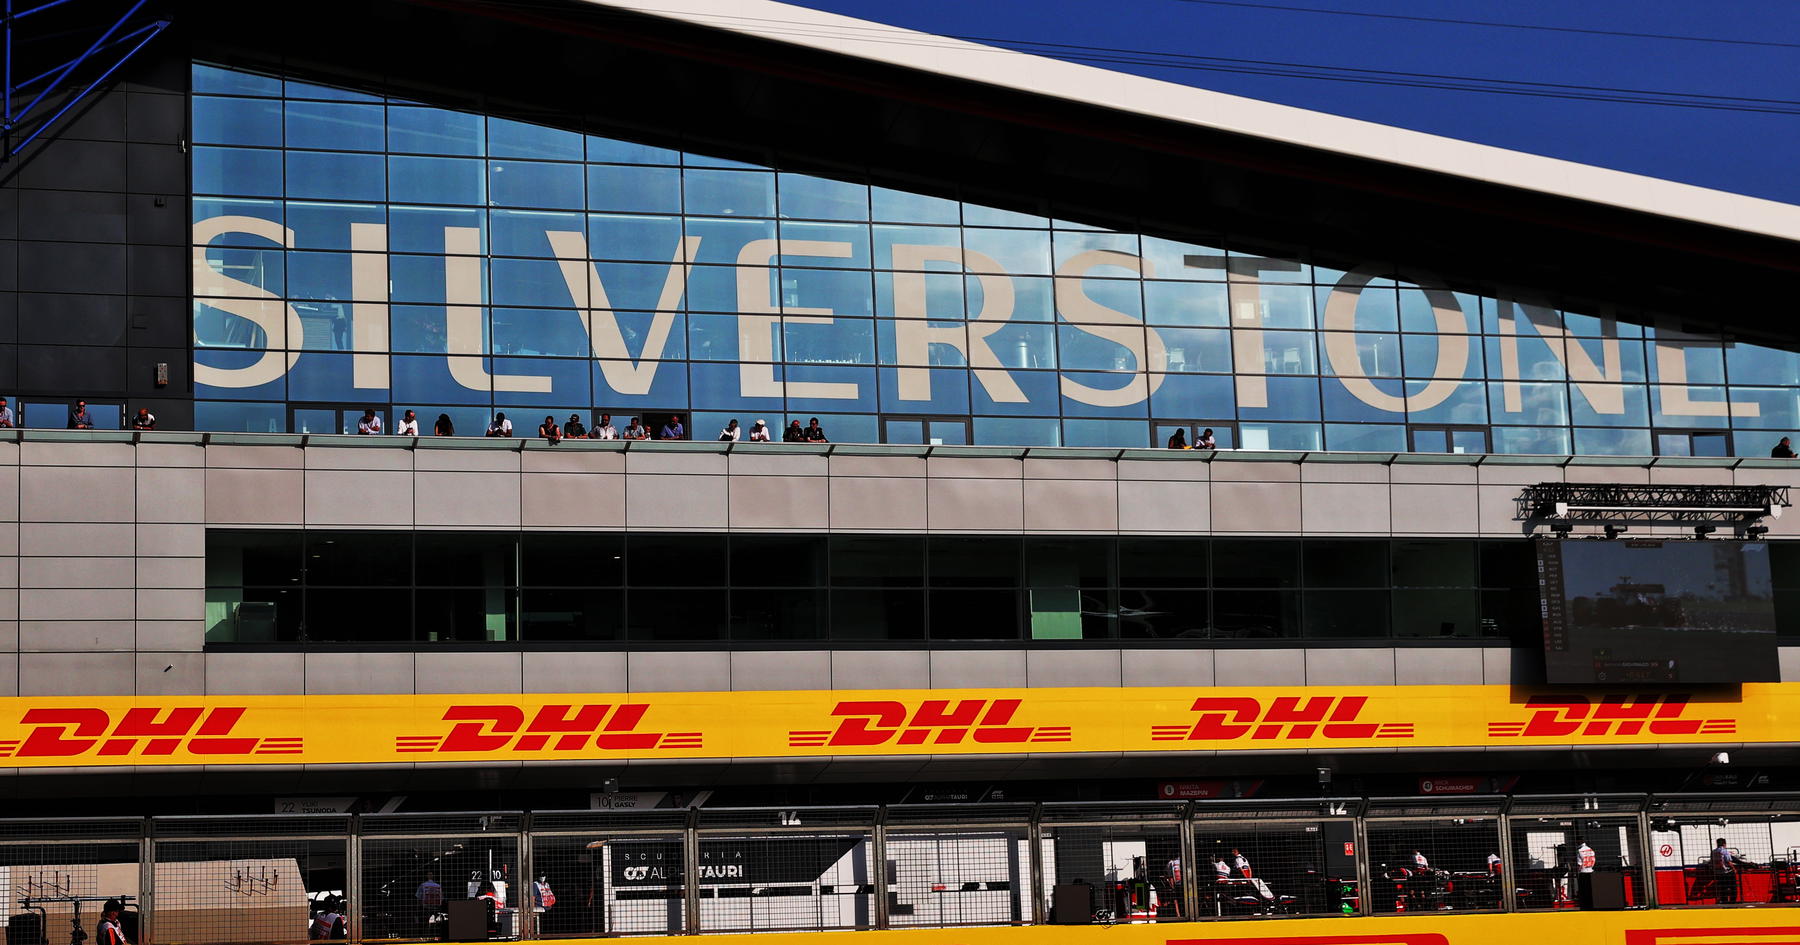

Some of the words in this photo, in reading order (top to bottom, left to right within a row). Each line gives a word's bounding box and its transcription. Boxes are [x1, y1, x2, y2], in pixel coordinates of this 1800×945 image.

[193, 215, 1760, 417] SILVERSTONE
[16, 708, 259, 756] DHL
[439, 704, 662, 751] DHL
[828, 700, 1034, 746] DHL
[1188, 697, 1379, 740] DHL
[1522, 695, 1703, 736] DHL
[471, 870, 483, 880] 22
[492, 869, 502, 880] 10
[624, 851, 742, 861] SCURIA
[650, 865, 743, 880] ALTAURI
